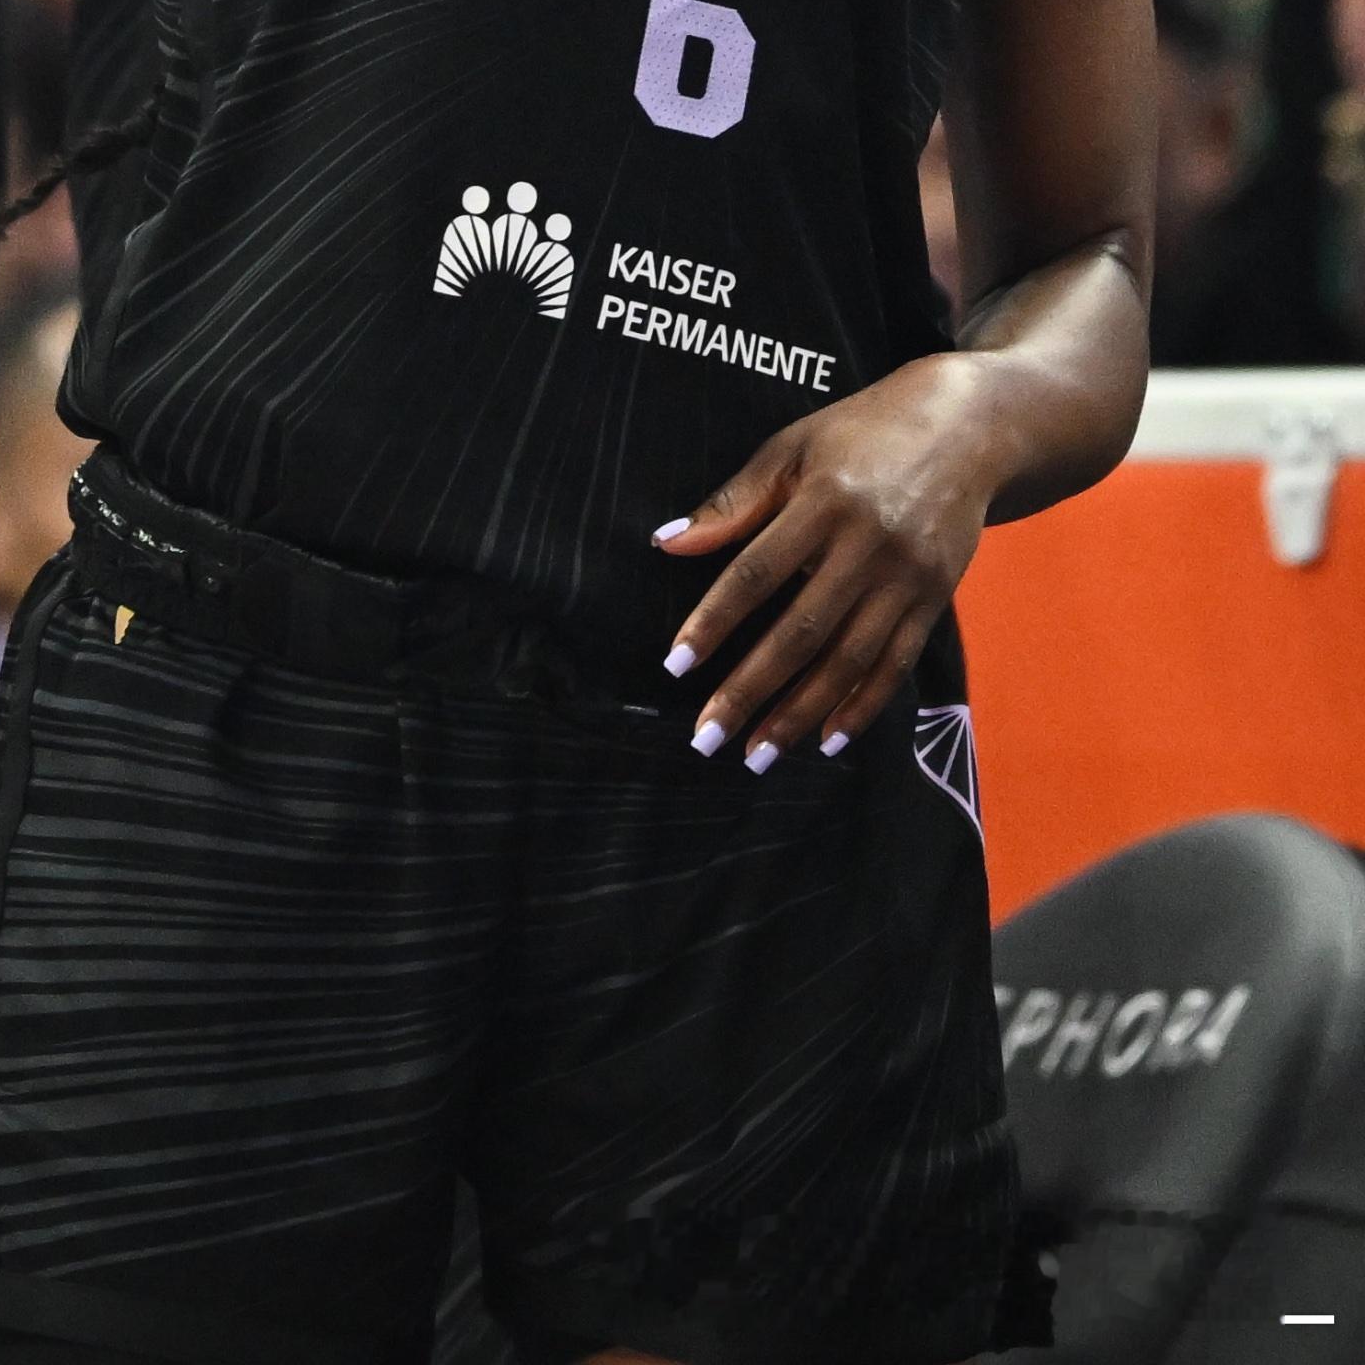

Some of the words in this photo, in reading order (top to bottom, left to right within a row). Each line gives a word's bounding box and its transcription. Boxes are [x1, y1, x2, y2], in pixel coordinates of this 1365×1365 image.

[607, 243, 737, 308] KAISER
[596, 294, 837, 393] PERMANENTE
[993, 984, 1251, 1078] PHORA
